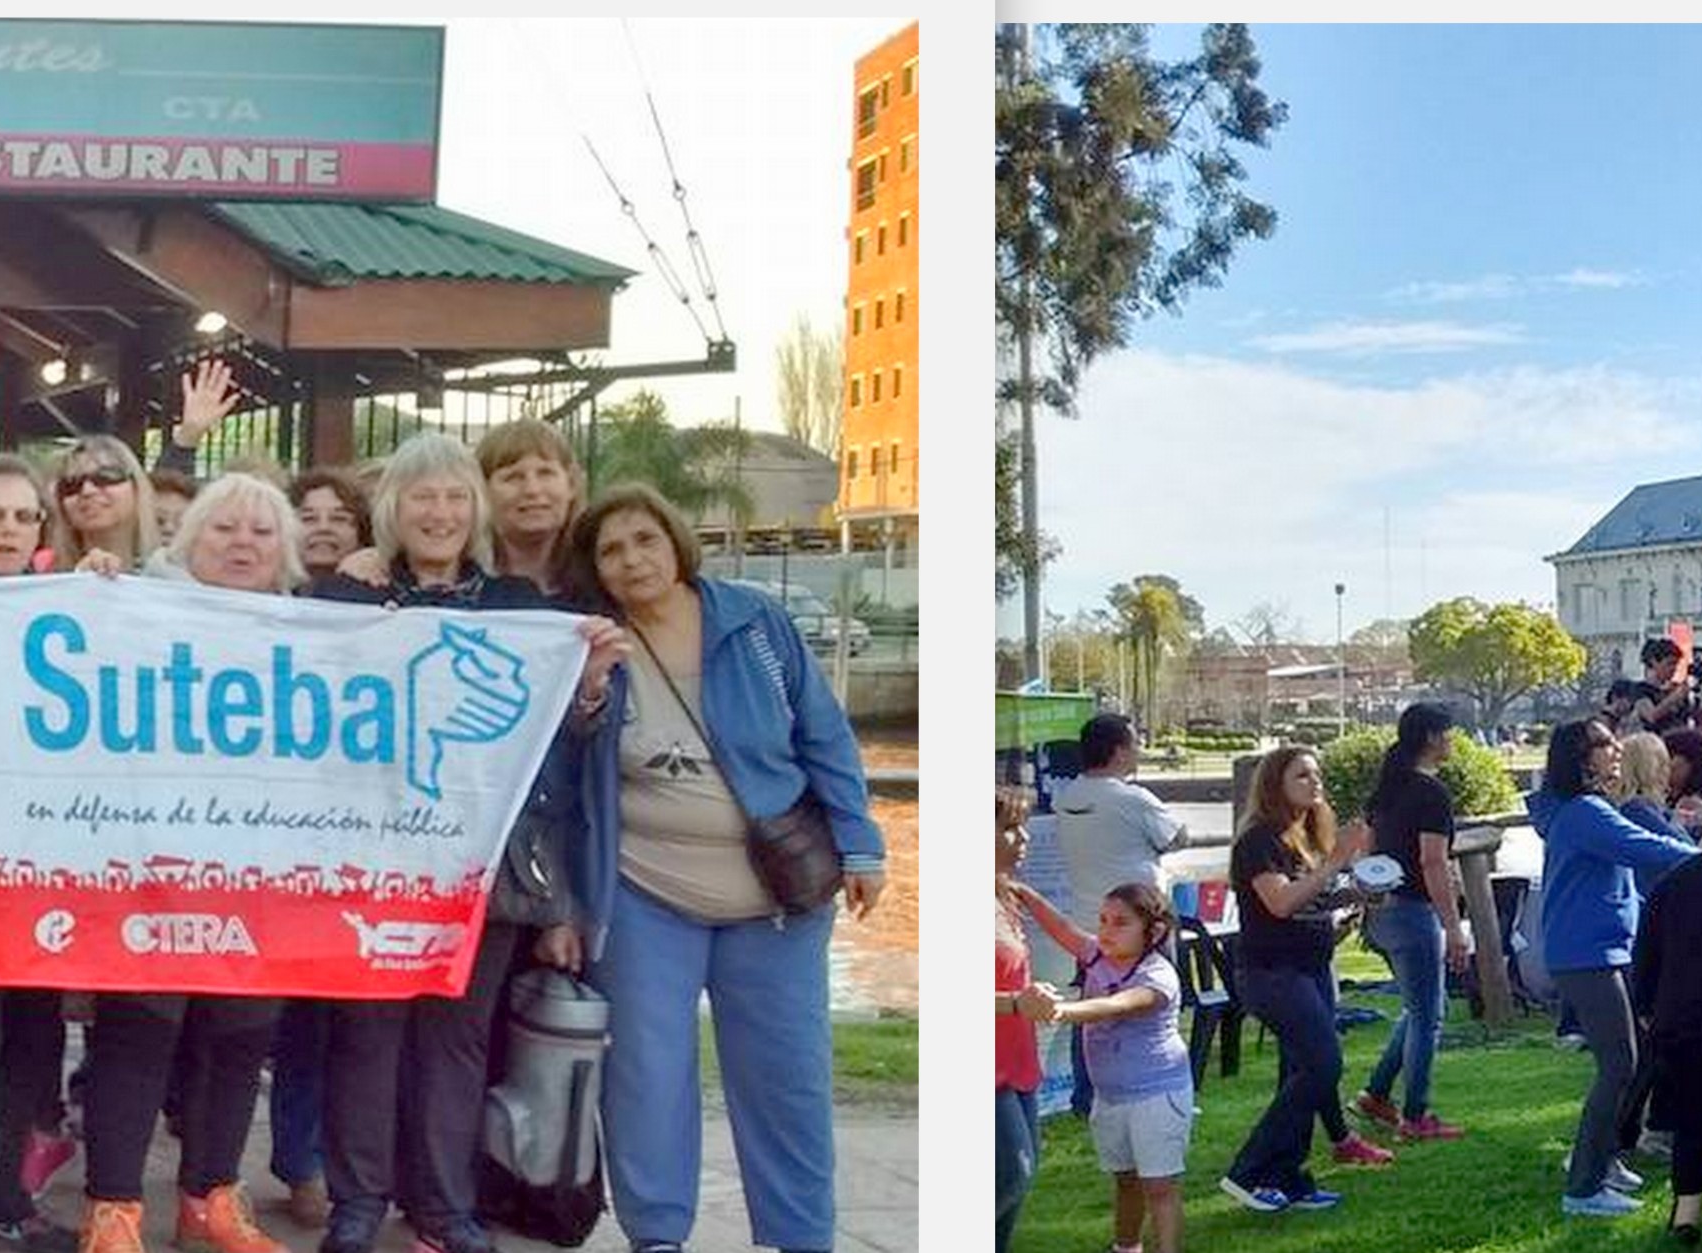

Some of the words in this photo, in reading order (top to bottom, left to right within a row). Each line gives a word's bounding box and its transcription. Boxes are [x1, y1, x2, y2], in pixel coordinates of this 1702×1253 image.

[162, 96, 261, 122] CTA
[21, 612, 397, 765] Suteba
[25, 801, 55, 820] en
[63, 793, 158, 835] defensa
[167, 795, 196, 824] de
[204, 795, 234, 826] la
[243, 797, 373, 831] educación
[380, 805, 466, 841] pública
[120, 912, 261, 956] CTERA
